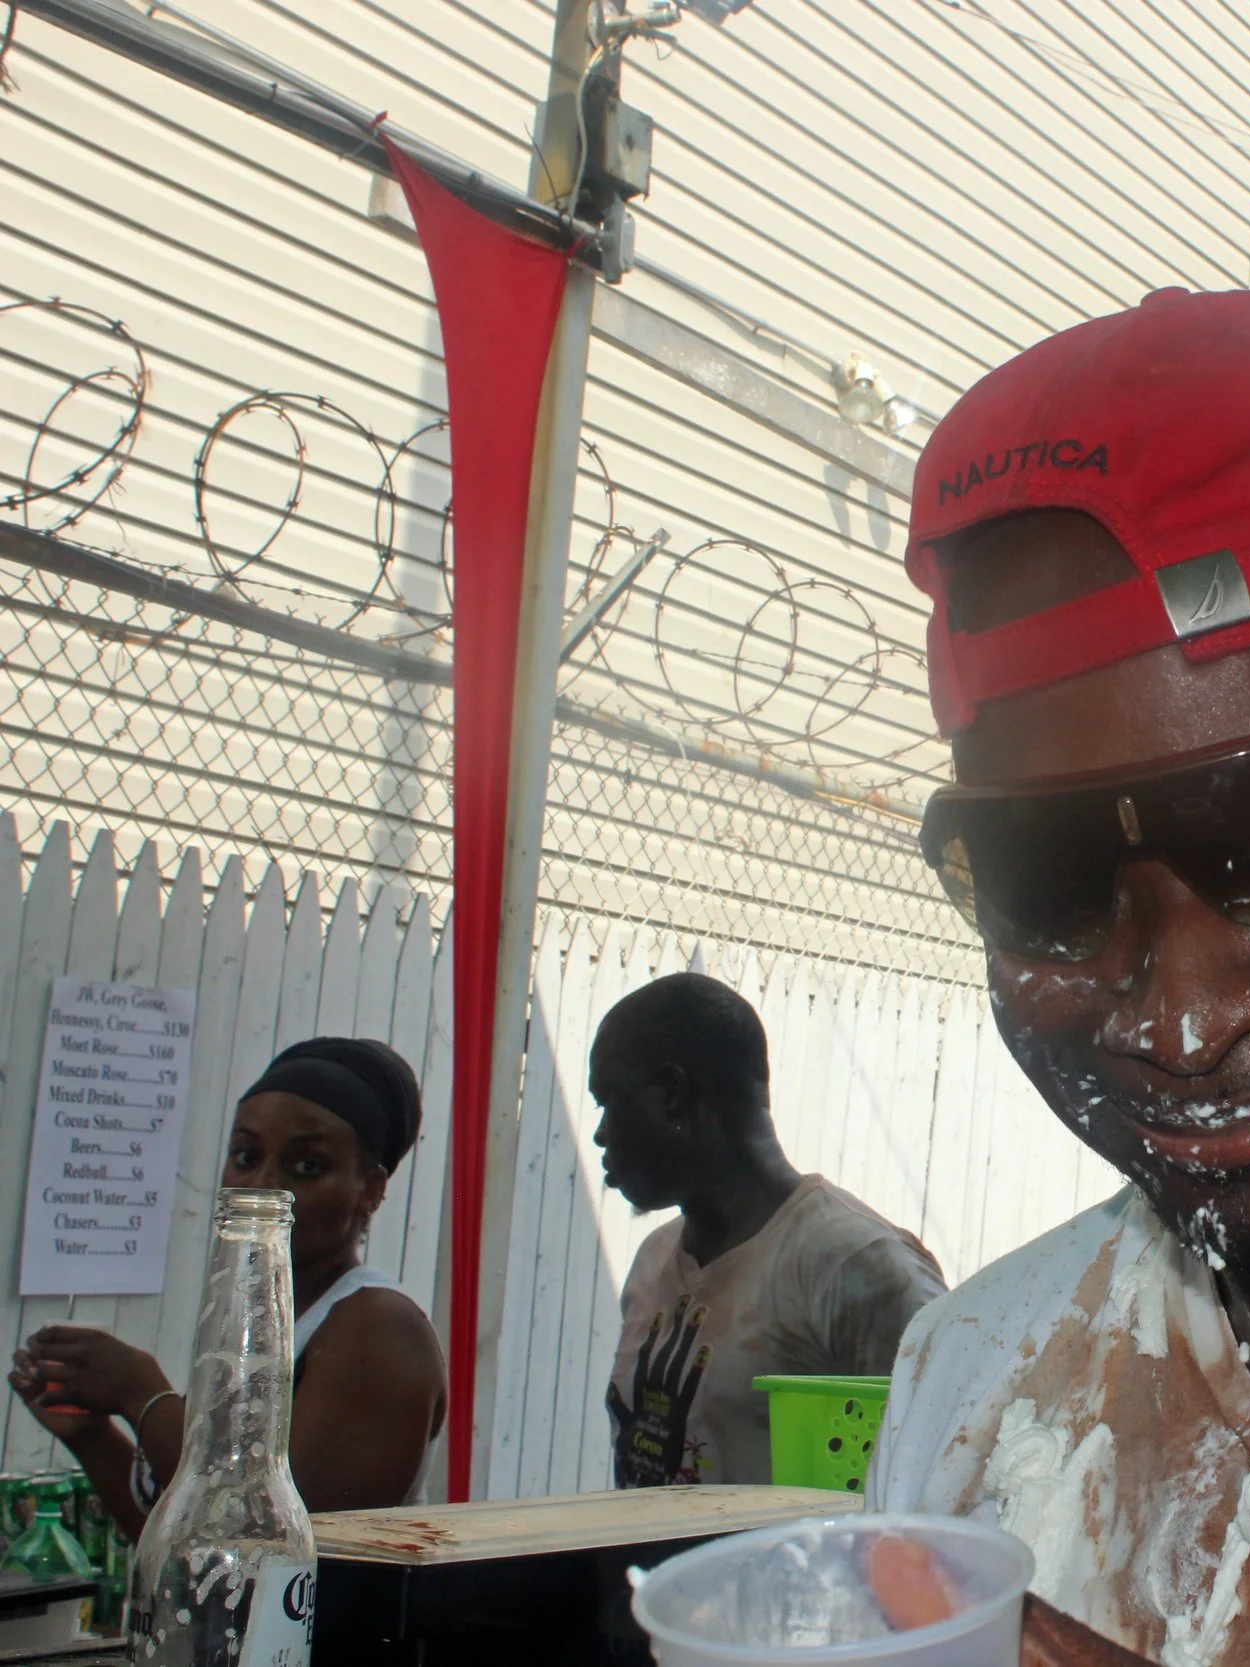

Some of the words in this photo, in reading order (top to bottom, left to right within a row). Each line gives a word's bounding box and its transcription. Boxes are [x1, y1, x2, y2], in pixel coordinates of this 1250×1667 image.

[938, 439, 1109, 506] NAUTICA
[52, 1060, 99, 1080] Moscato
[50, 1085, 84, 1104] Mixed
[55, 1111, 90, 1129] Cocoa
[43, 1186, 91, 1205] Coconut
